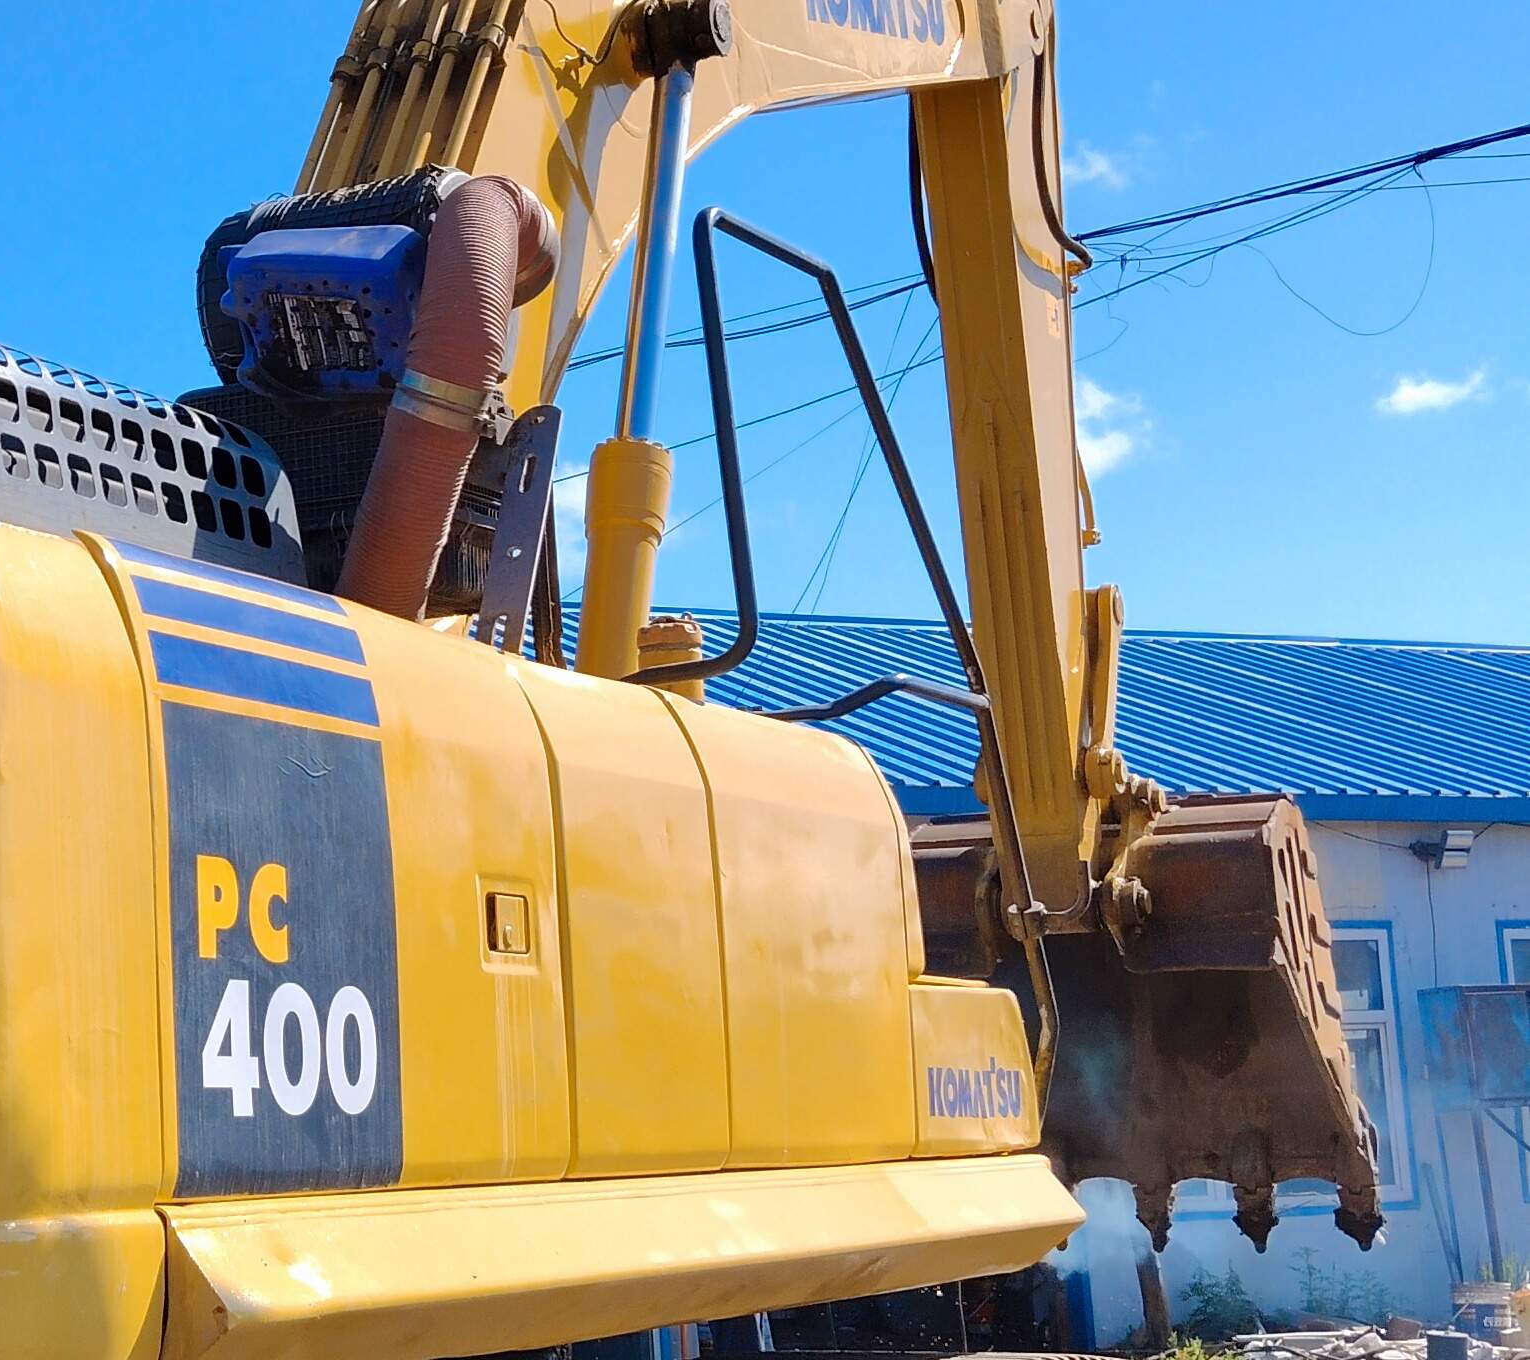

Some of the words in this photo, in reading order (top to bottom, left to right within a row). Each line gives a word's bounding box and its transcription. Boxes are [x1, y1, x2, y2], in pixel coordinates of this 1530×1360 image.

[197, 854, 289, 964] PC
[202, 979, 377, 1117] 400
[927, 1056, 1021, 1119] KOMATSU
